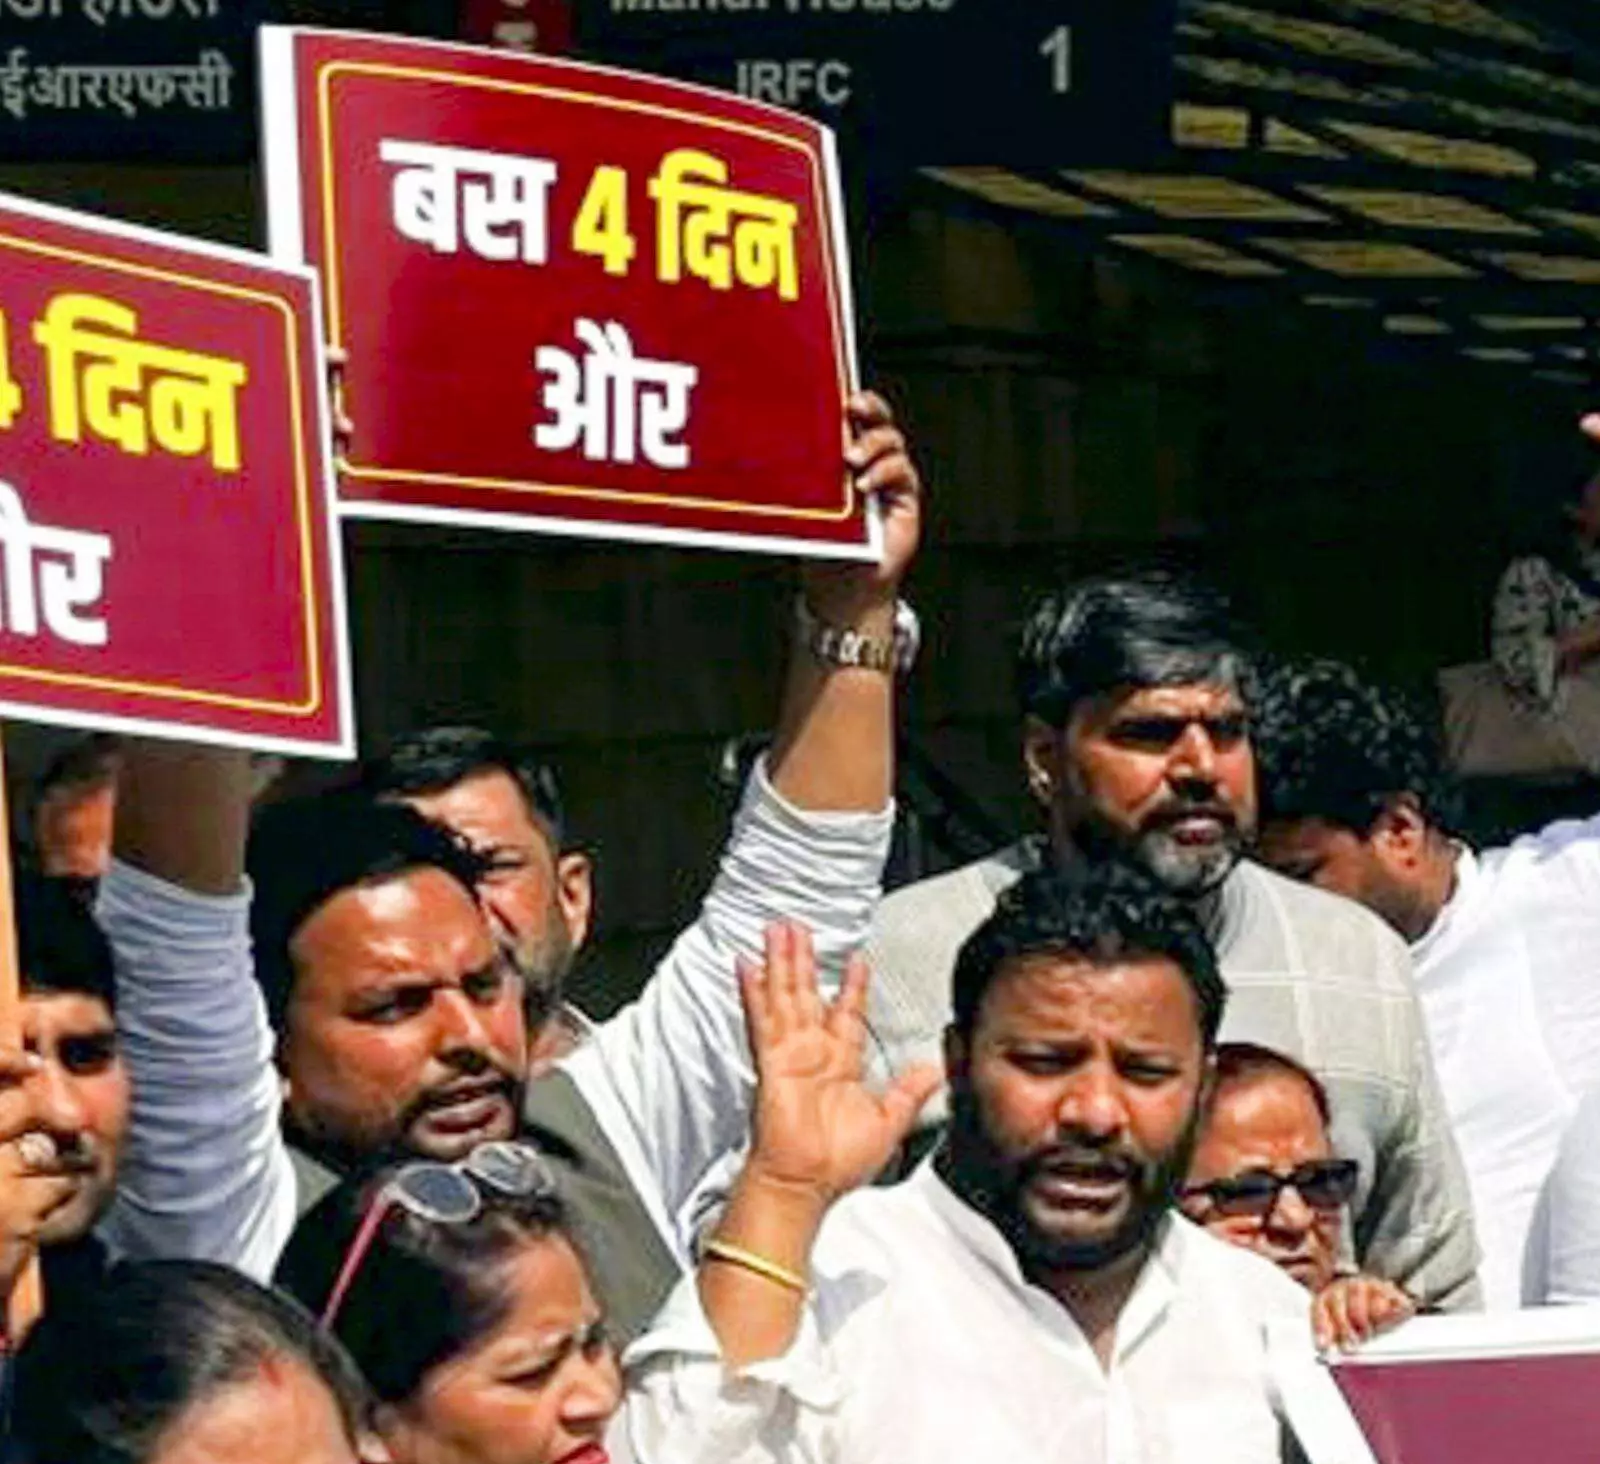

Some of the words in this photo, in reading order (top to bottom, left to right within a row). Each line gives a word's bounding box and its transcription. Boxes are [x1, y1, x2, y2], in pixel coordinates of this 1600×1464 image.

[735, 60, 852, 103] IRFC
[1040, 26, 1070, 93] 1
[379, 139, 557, 265] बस
[572, 165, 636, 274] 4
[650, 150, 799, 300] दिन
[34, 293, 246, 471] दिन
[535, 318, 697, 468] और
